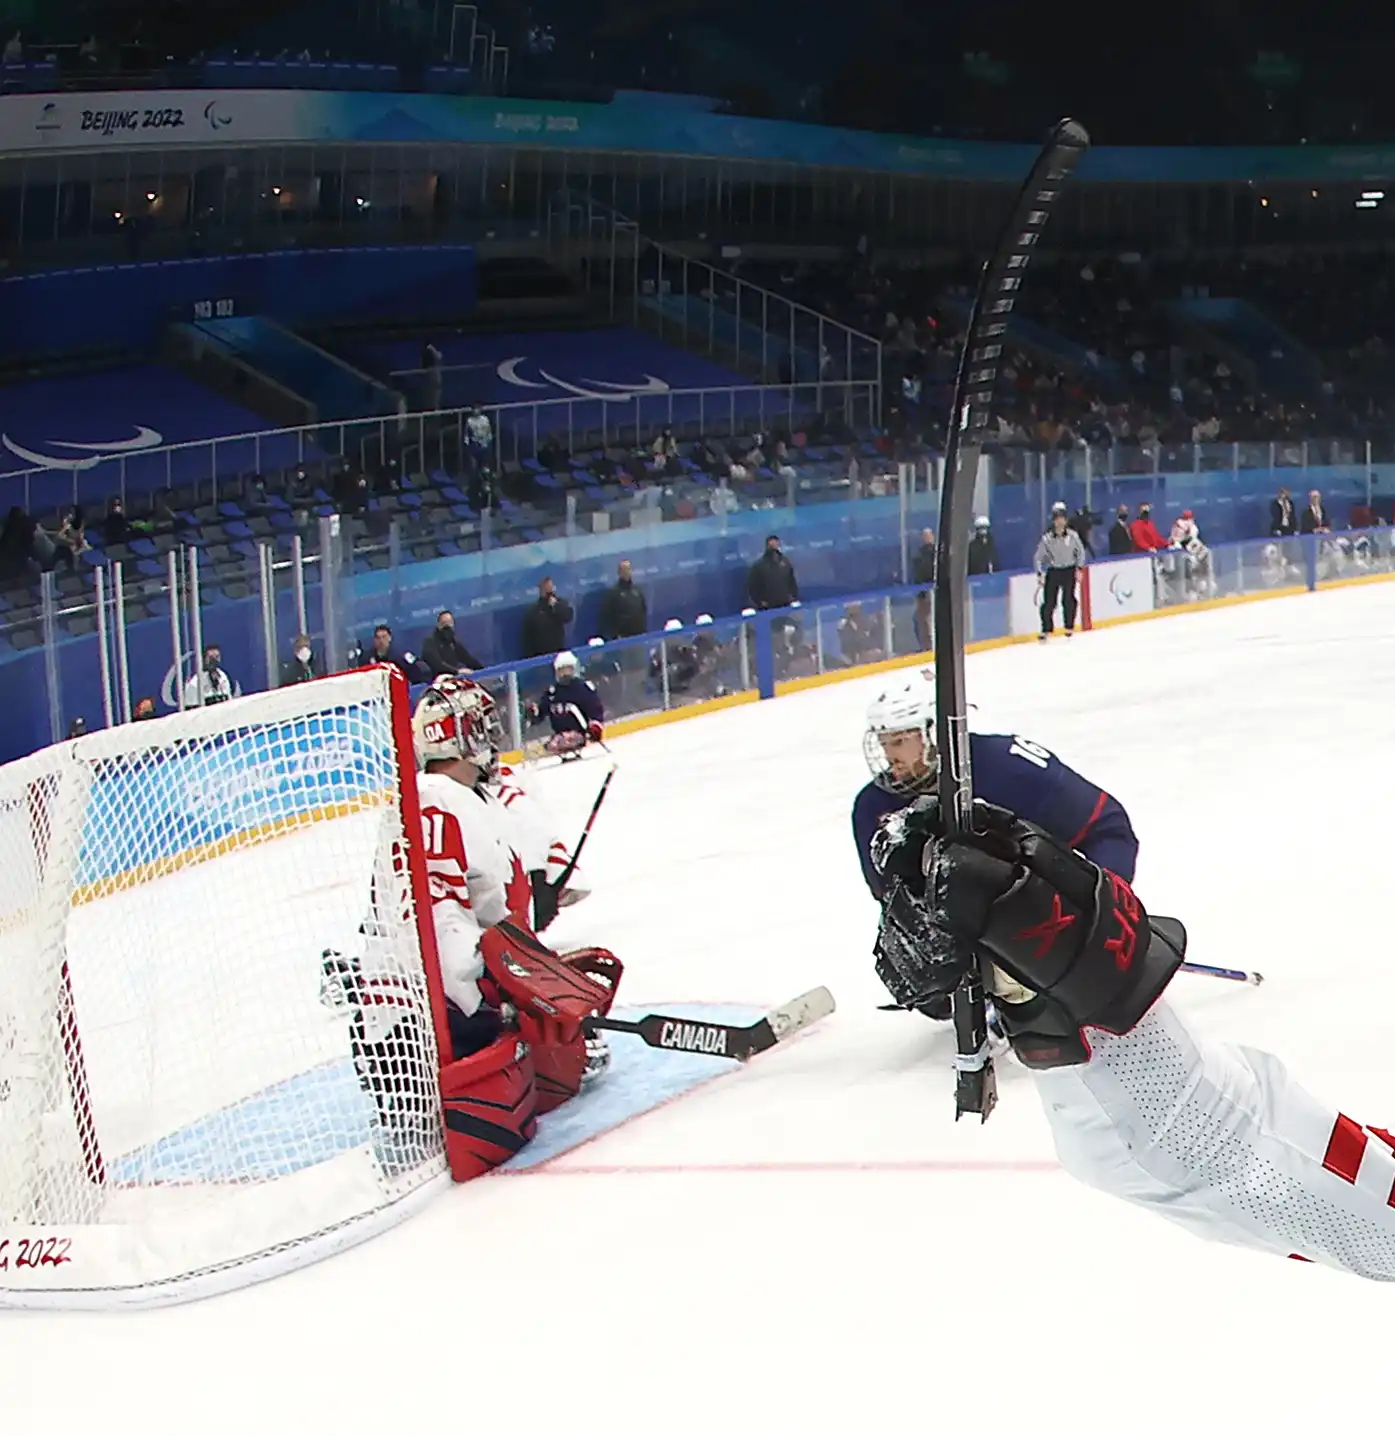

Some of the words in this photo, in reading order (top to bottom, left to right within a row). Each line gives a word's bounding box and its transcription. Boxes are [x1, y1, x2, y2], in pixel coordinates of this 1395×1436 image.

[81, 110, 139, 136] BEIJING
[142, 108, 185, 128] 2022
[661, 1021, 727, 1054] CANADA
[16, 1236, 72, 1268] 2022
